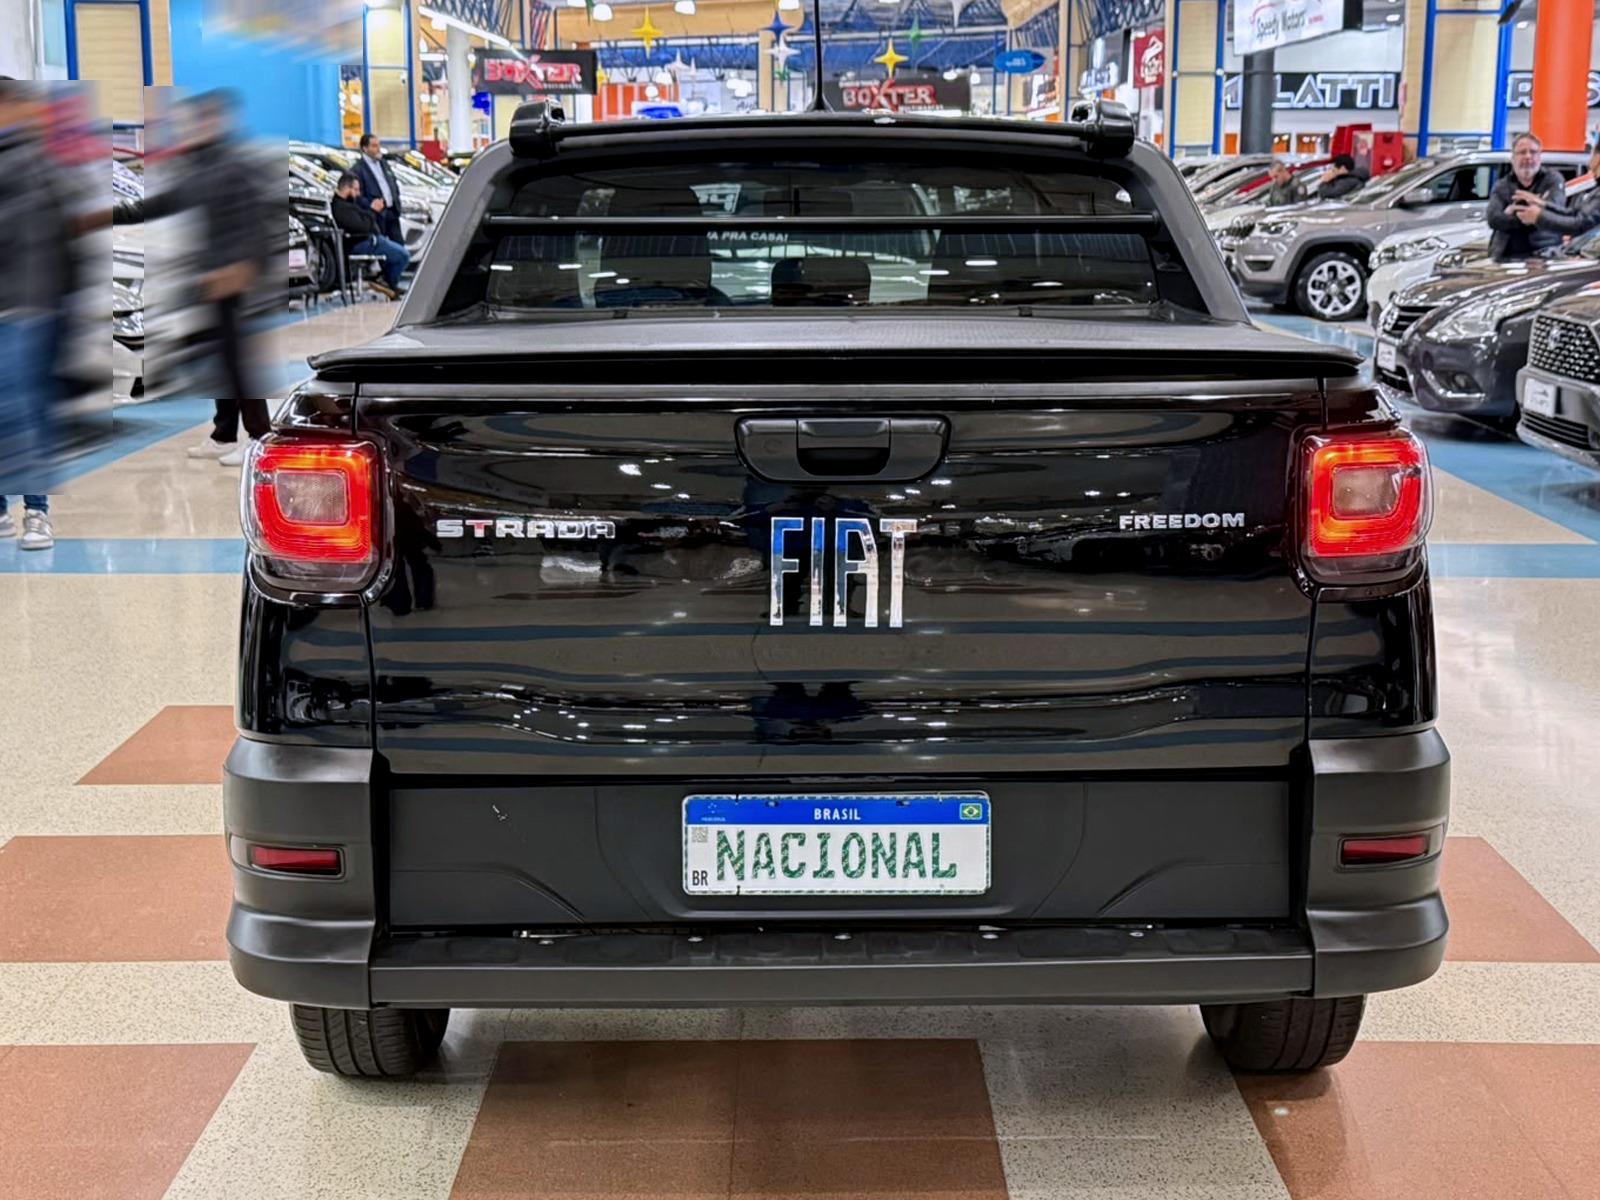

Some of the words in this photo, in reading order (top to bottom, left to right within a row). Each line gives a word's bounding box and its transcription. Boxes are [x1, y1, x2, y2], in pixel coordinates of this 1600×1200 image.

[842, 79, 936, 112] BOXTER
[722, 231, 747, 240] PRA
[750, 232, 788, 243] CASA!
[436, 519, 617, 539] STRADA
[1119, 512, 1246, 530] FREEDOM
[770, 517, 918, 628] FIAT
[813, 807, 862, 821] BRASIL
[716, 830, 957, 881] NACIONAL
[692, 870, 709, 886] BR
